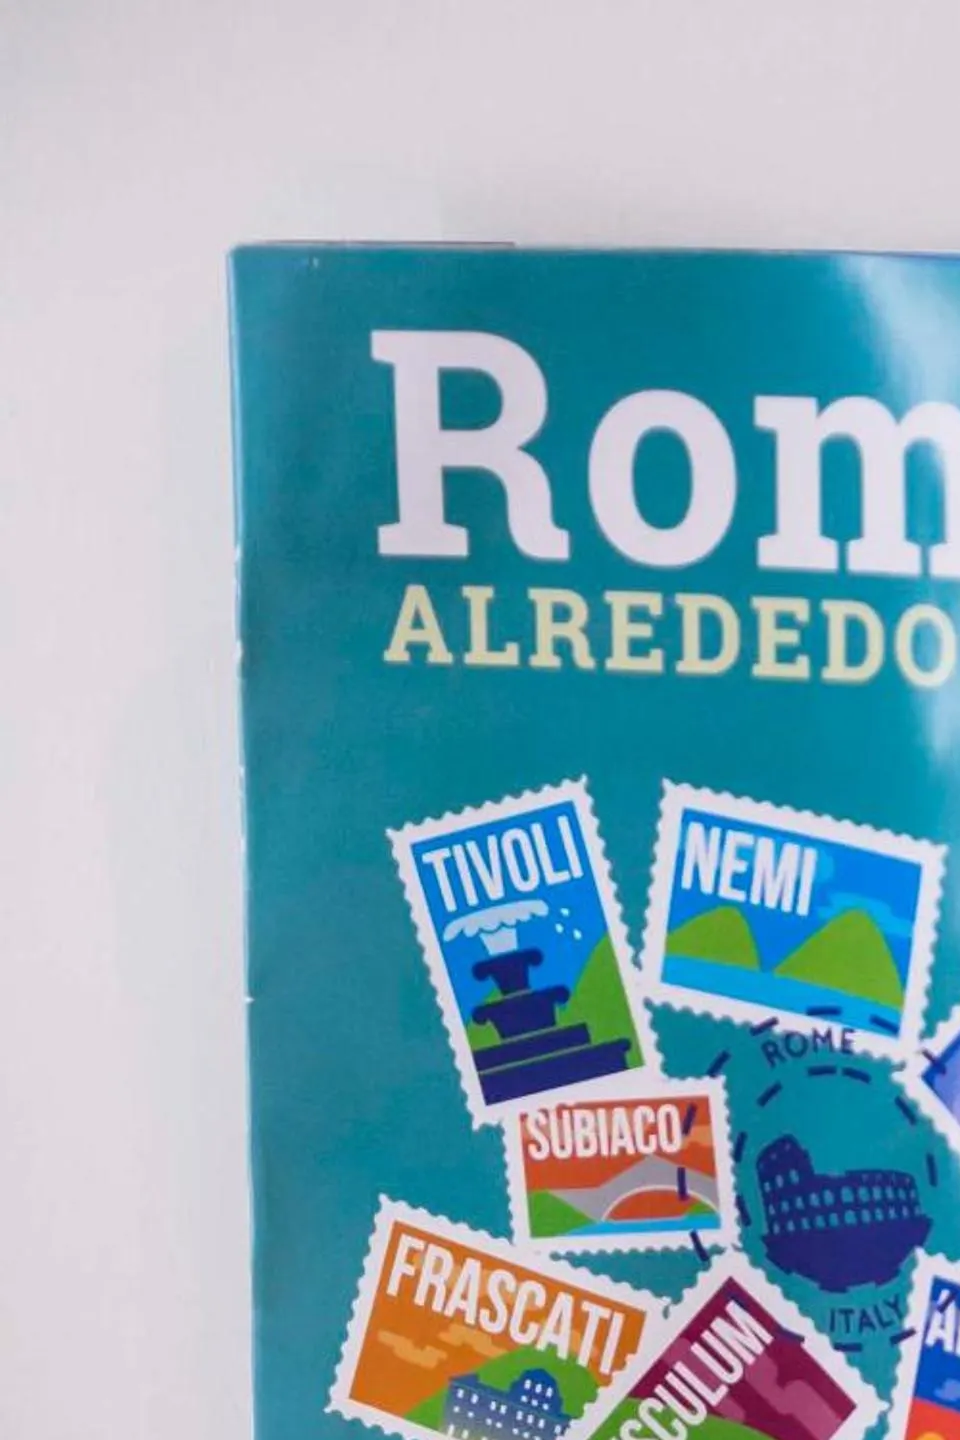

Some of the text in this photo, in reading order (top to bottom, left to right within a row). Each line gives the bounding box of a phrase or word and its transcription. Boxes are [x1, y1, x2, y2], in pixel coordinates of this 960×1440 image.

[422, 815, 584, 914] TIVOLI
[681, 821, 818, 917] NEMI
[761, 1027, 856, 1068] ROME
[525, 1103, 684, 1161] SUBIACO
[386, 1233, 626, 1376] FRASCATI
[829, 1293, 903, 1334] ITALY
